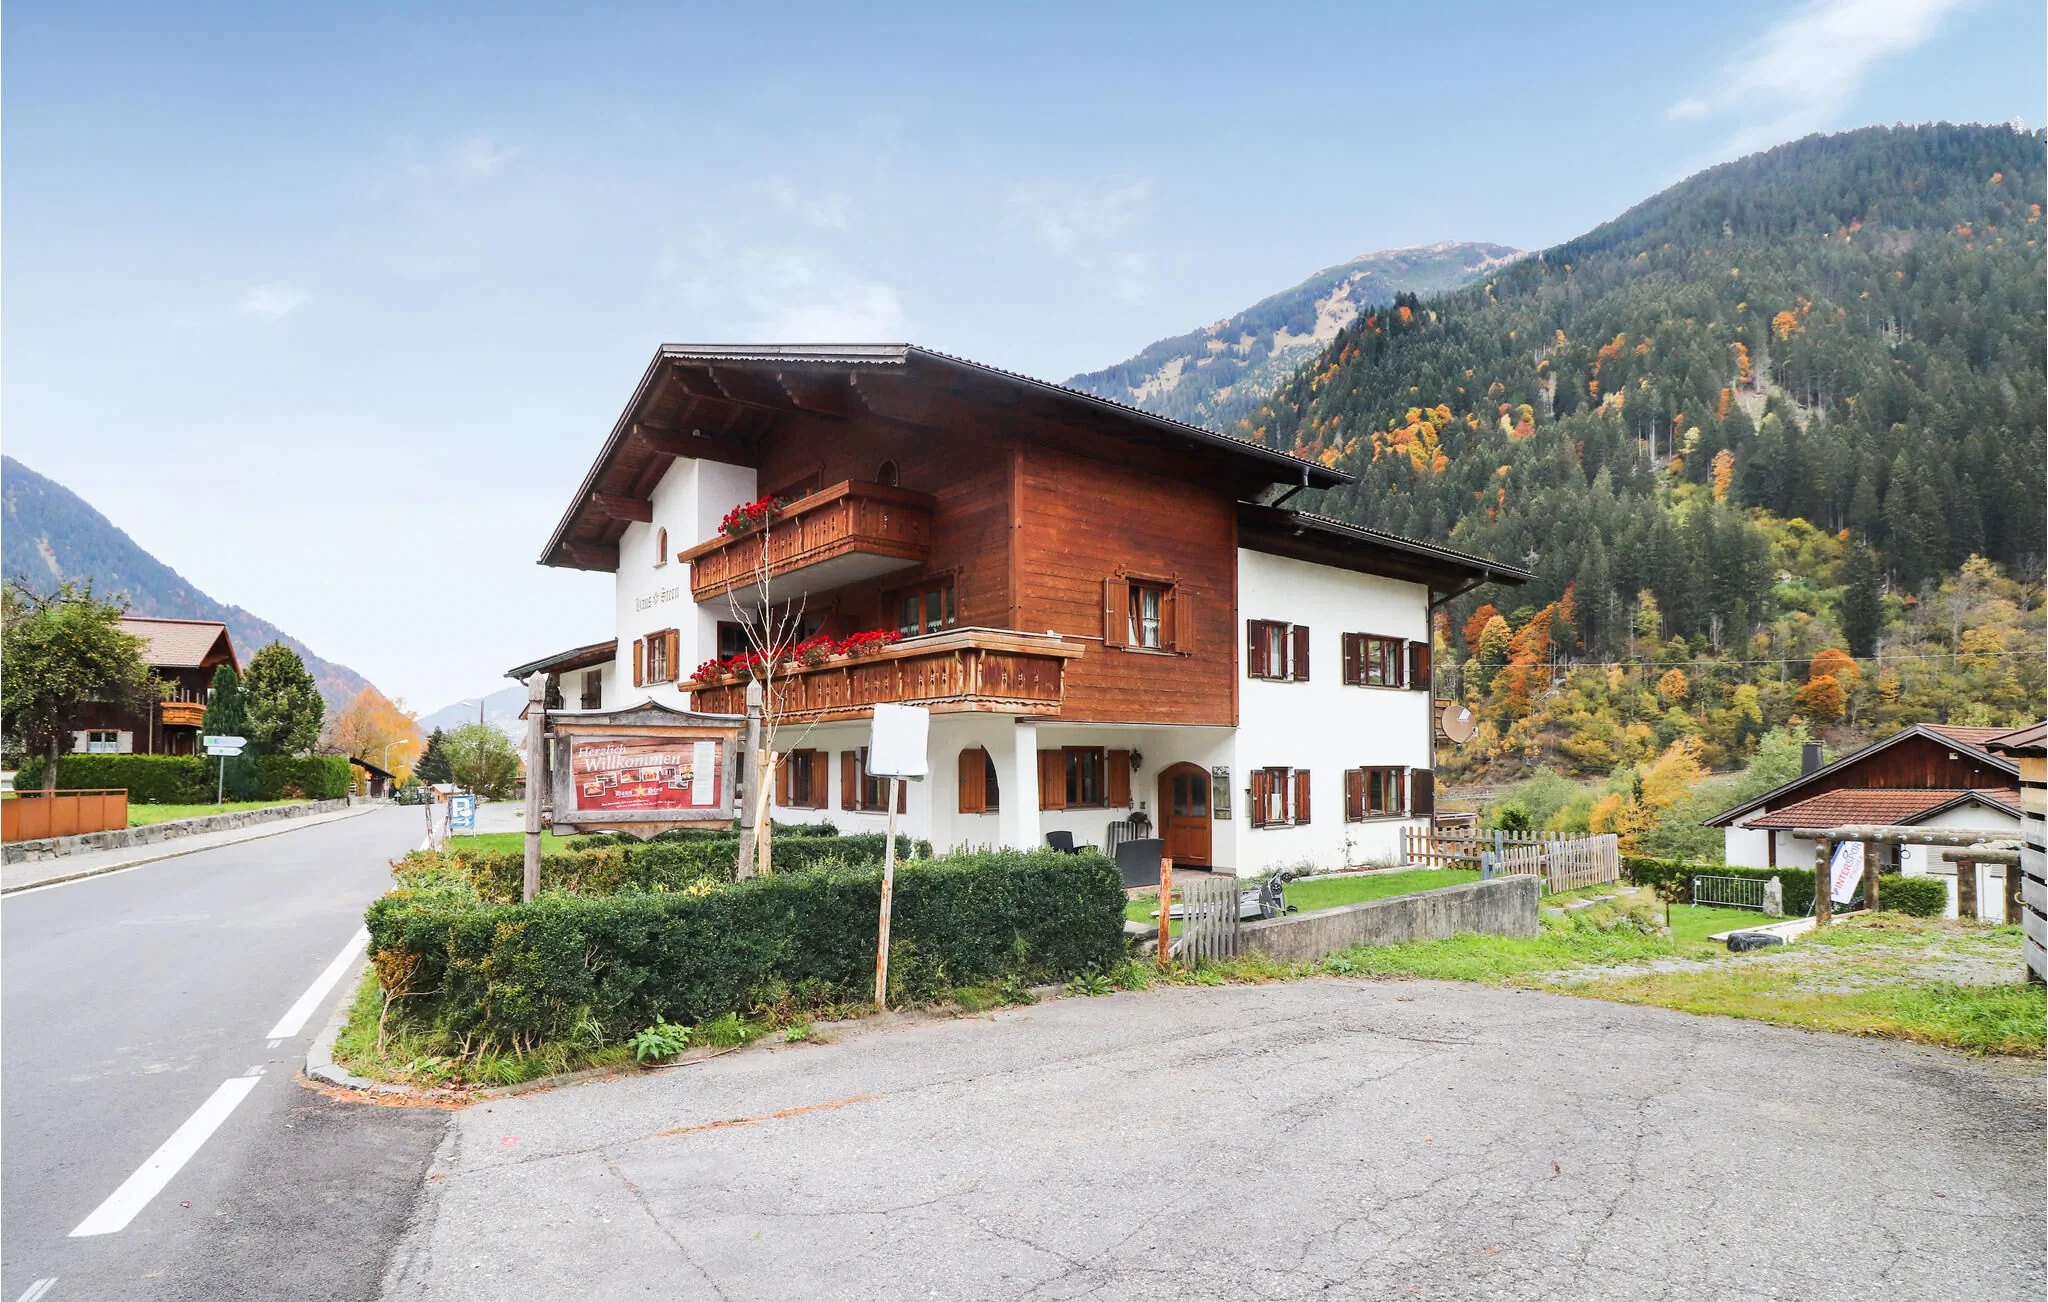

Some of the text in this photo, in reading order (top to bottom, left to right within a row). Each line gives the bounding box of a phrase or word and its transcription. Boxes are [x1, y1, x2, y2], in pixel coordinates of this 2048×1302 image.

[578, 744, 627, 758] Herzlich
[584, 753, 681, 772] Willkommen
[1835, 842, 1862, 889] INTERSPOR
